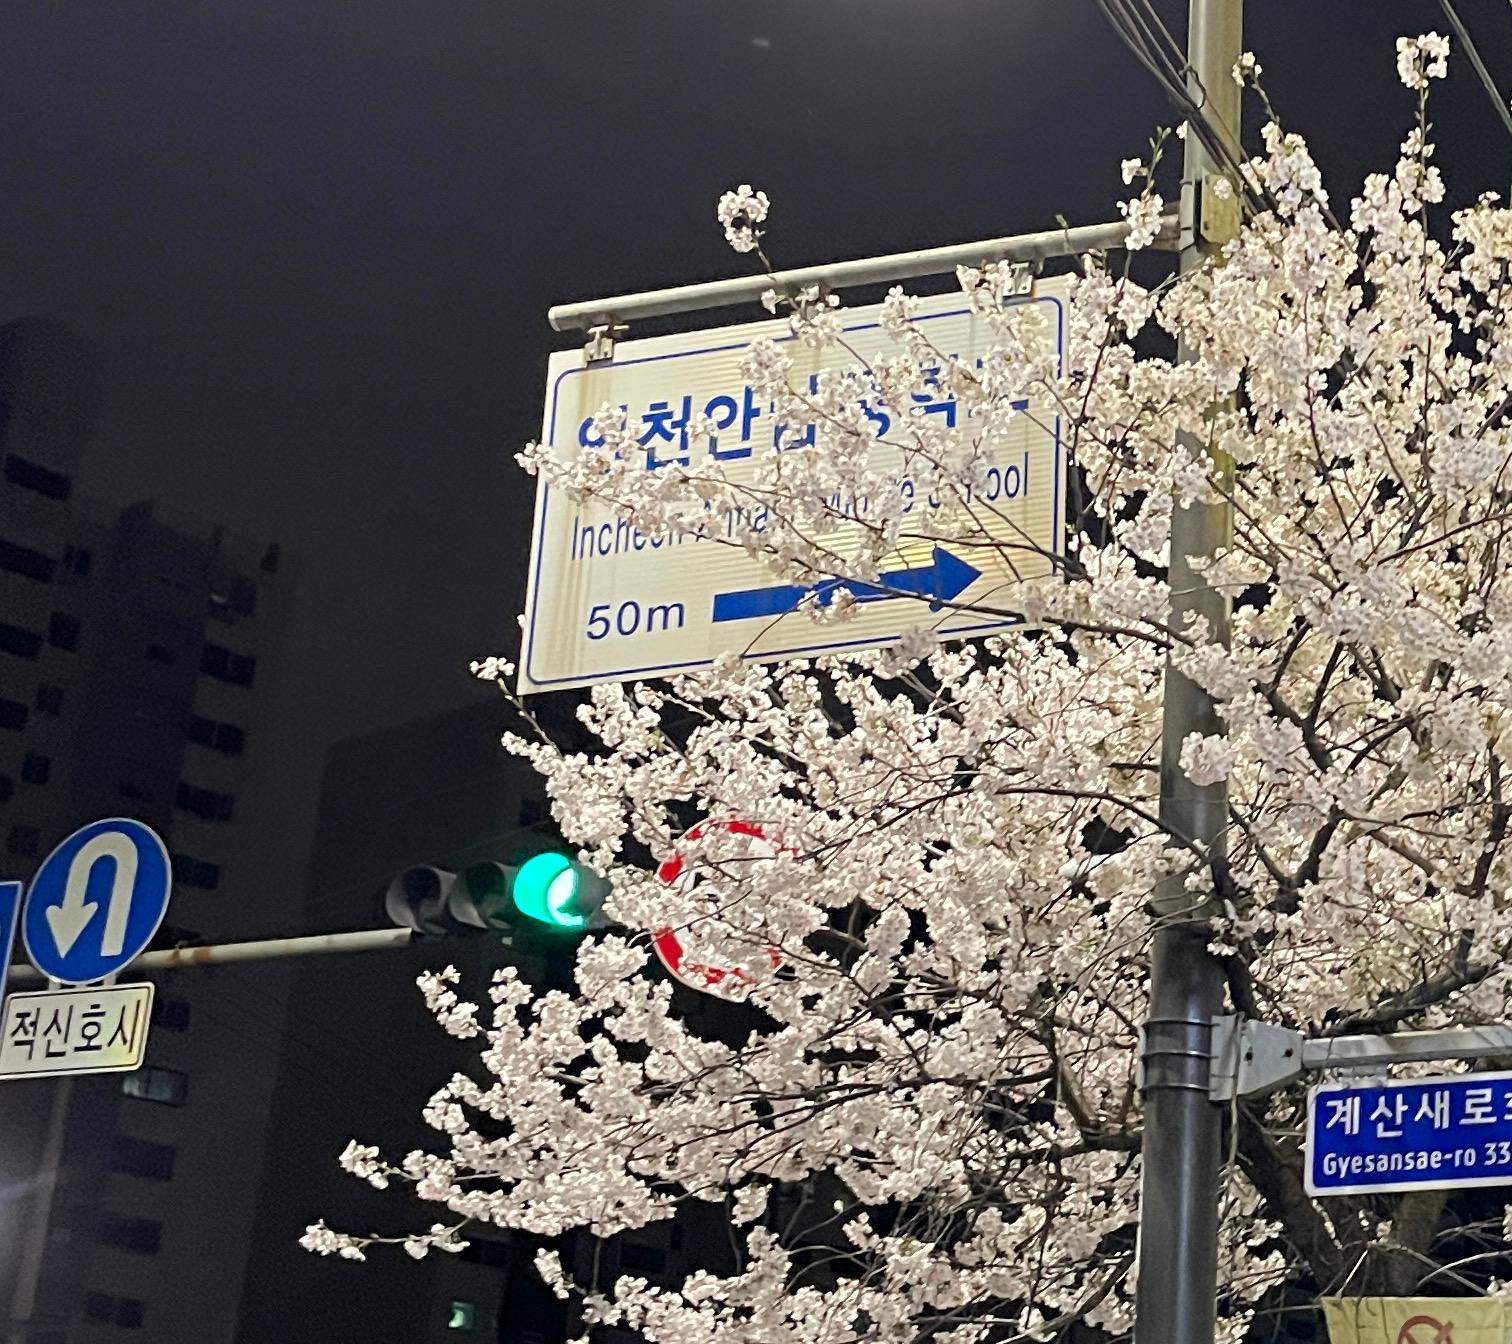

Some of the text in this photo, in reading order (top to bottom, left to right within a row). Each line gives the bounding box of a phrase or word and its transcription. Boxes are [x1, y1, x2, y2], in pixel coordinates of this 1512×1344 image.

[586, 599, 685, 641] 50m
[9, 999, 138, 1060] 적신호시
[1323, 1150, 1476, 1179] Gyesansae-ro
